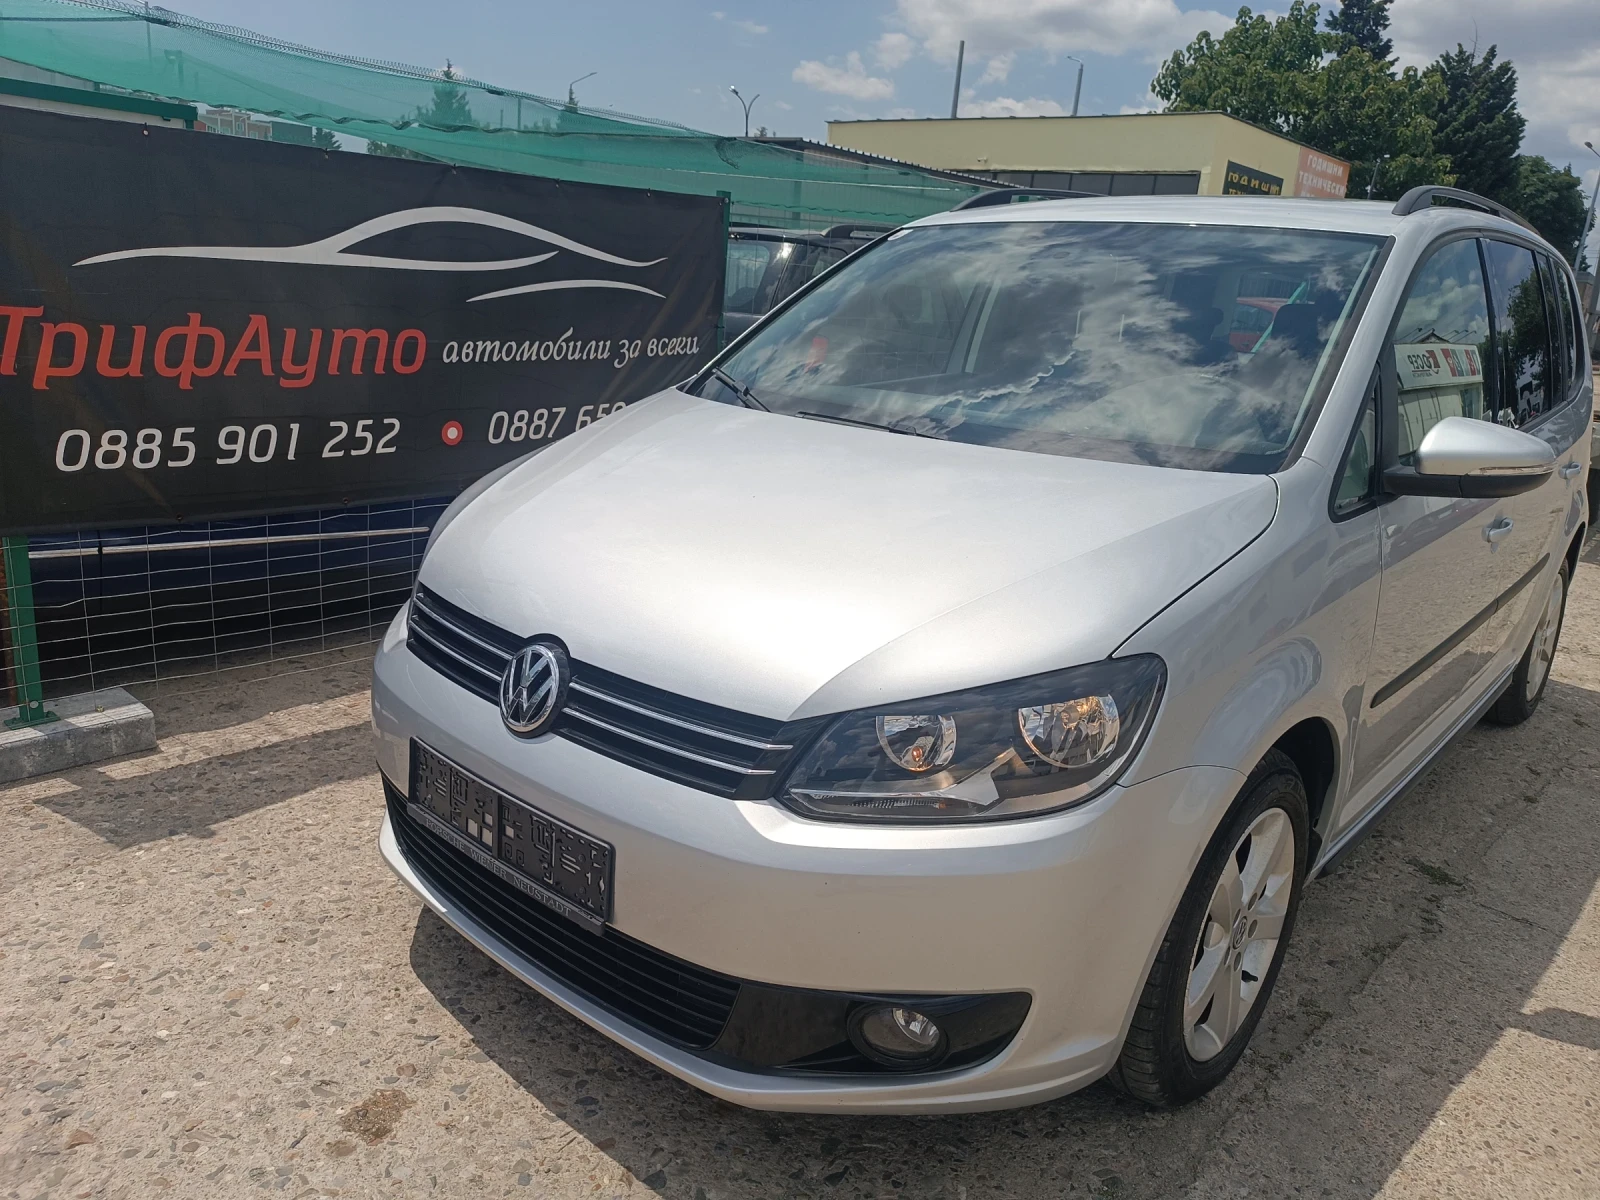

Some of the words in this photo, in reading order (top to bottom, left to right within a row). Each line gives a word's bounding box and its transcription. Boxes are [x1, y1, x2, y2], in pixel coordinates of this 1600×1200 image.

[1307, 154, 1343, 177] ГОДИШНИ
[0, 305, 427, 390] ТрифАуто
[442, 327, 611, 363] автомобили
[613, 338, 642, 368] за
[647, 336, 700, 357] всеки
[55, 427, 196, 472] 0885
[216, 423, 300, 465] 901
[322, 418, 401, 459] 252
[487, 406, 567, 445] 0887
[426, 818, 465, 853] PORSCHE
[469, 848, 508, 880] WIENER
[512, 876, 572, 917] NEUSTADT
